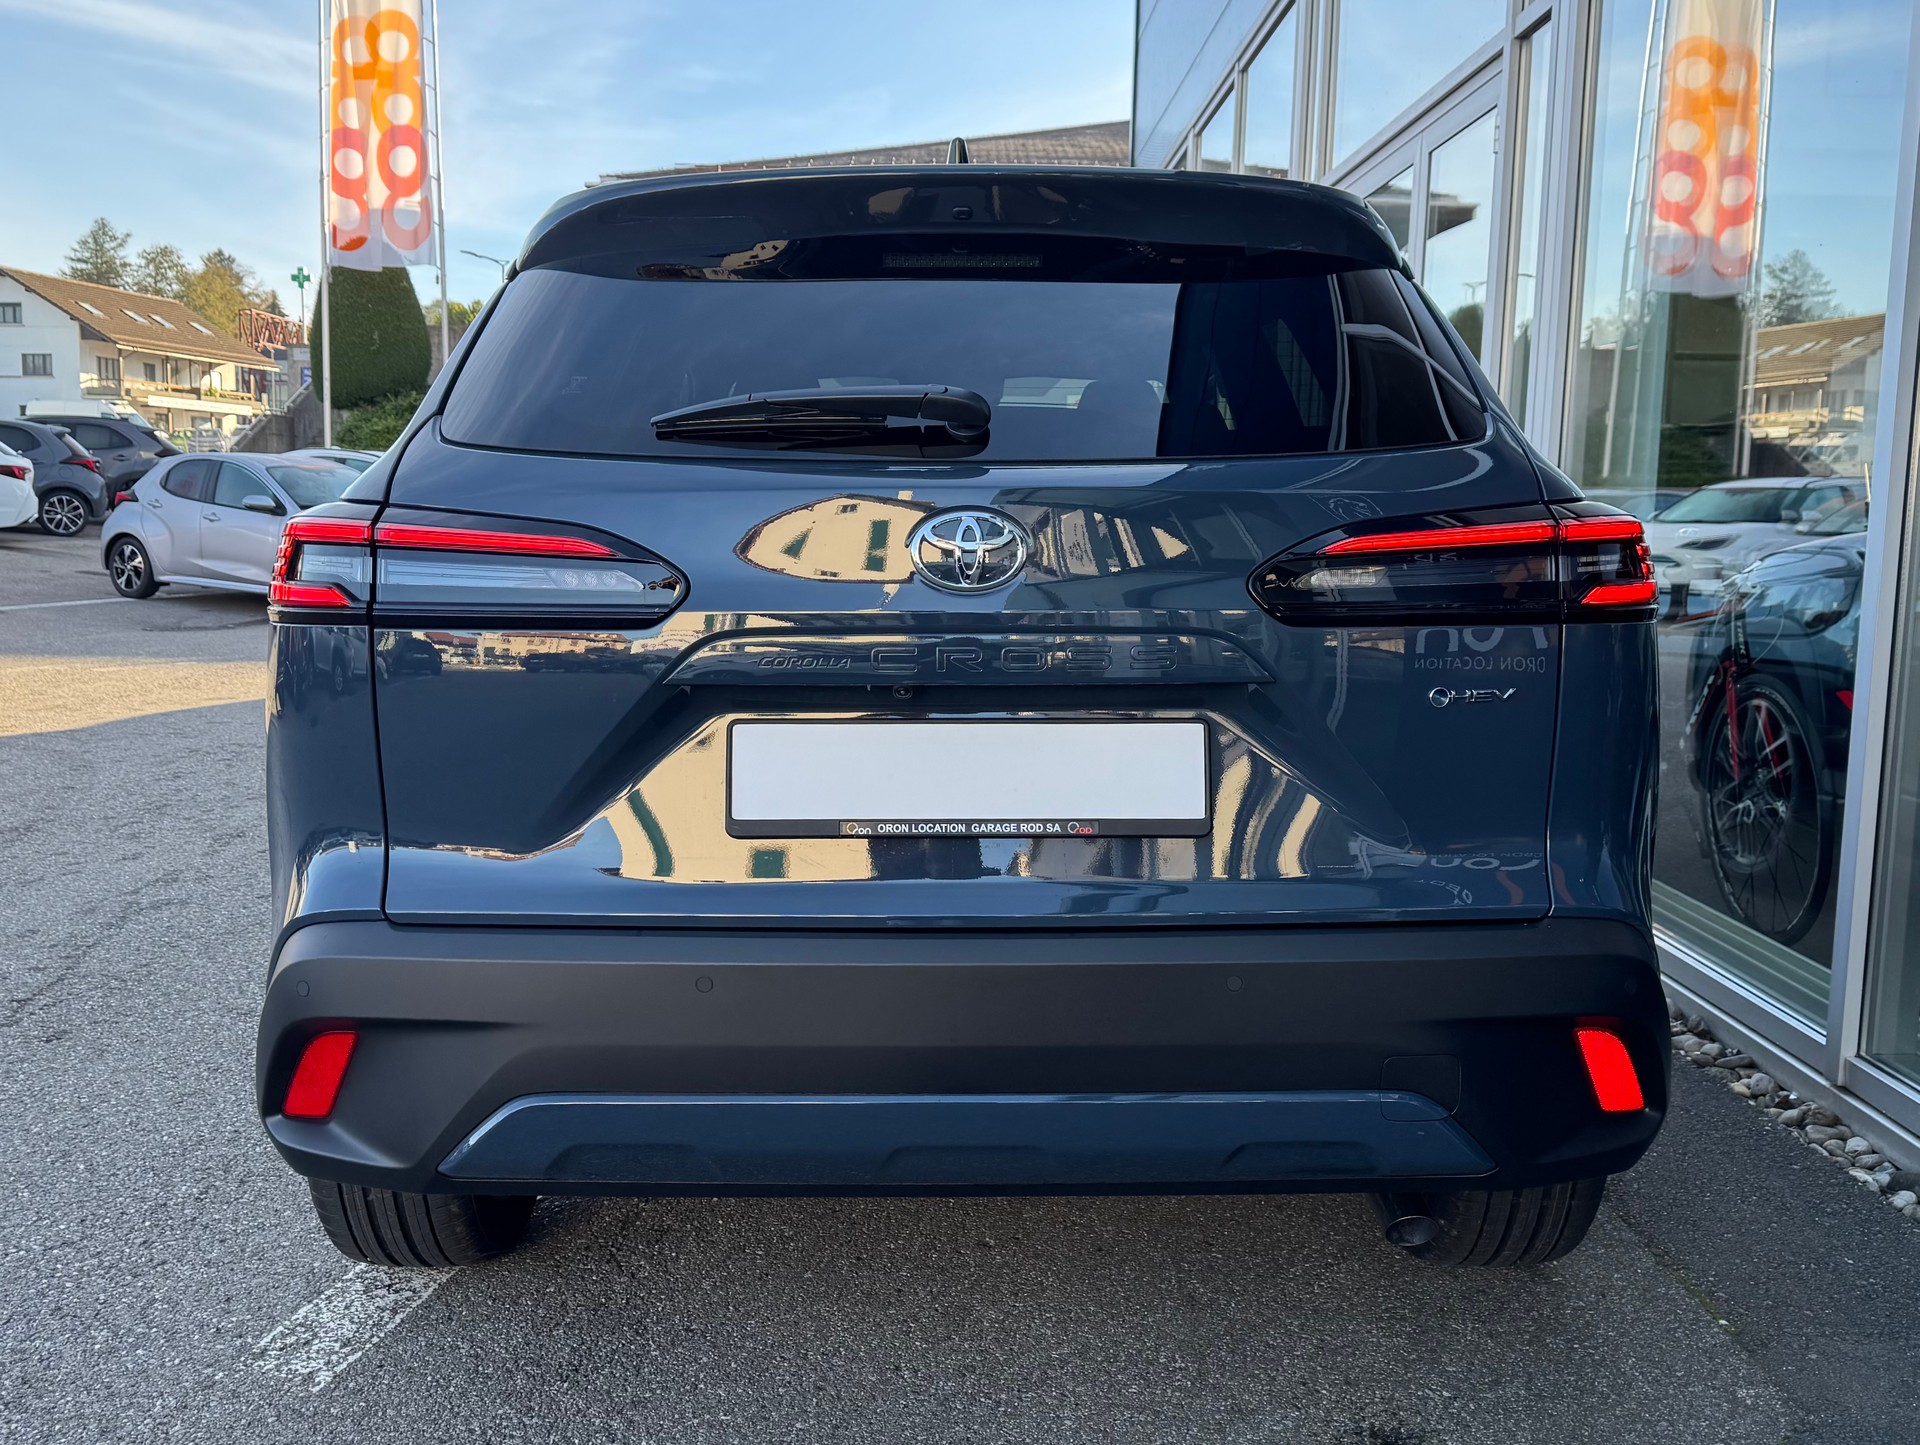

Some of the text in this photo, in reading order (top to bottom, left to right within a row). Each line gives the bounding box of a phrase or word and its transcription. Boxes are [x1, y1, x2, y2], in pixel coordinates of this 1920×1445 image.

[758, 645, 1178, 672] COROLLA CROSS
[877, 823, 909, 833] ORON
[911, 823, 966, 833] LOCATION
[971, 823, 1018, 833] GARAGE
[1020, 823, 1044, 833] ROD
[1046, 823, 1061, 833] SA
